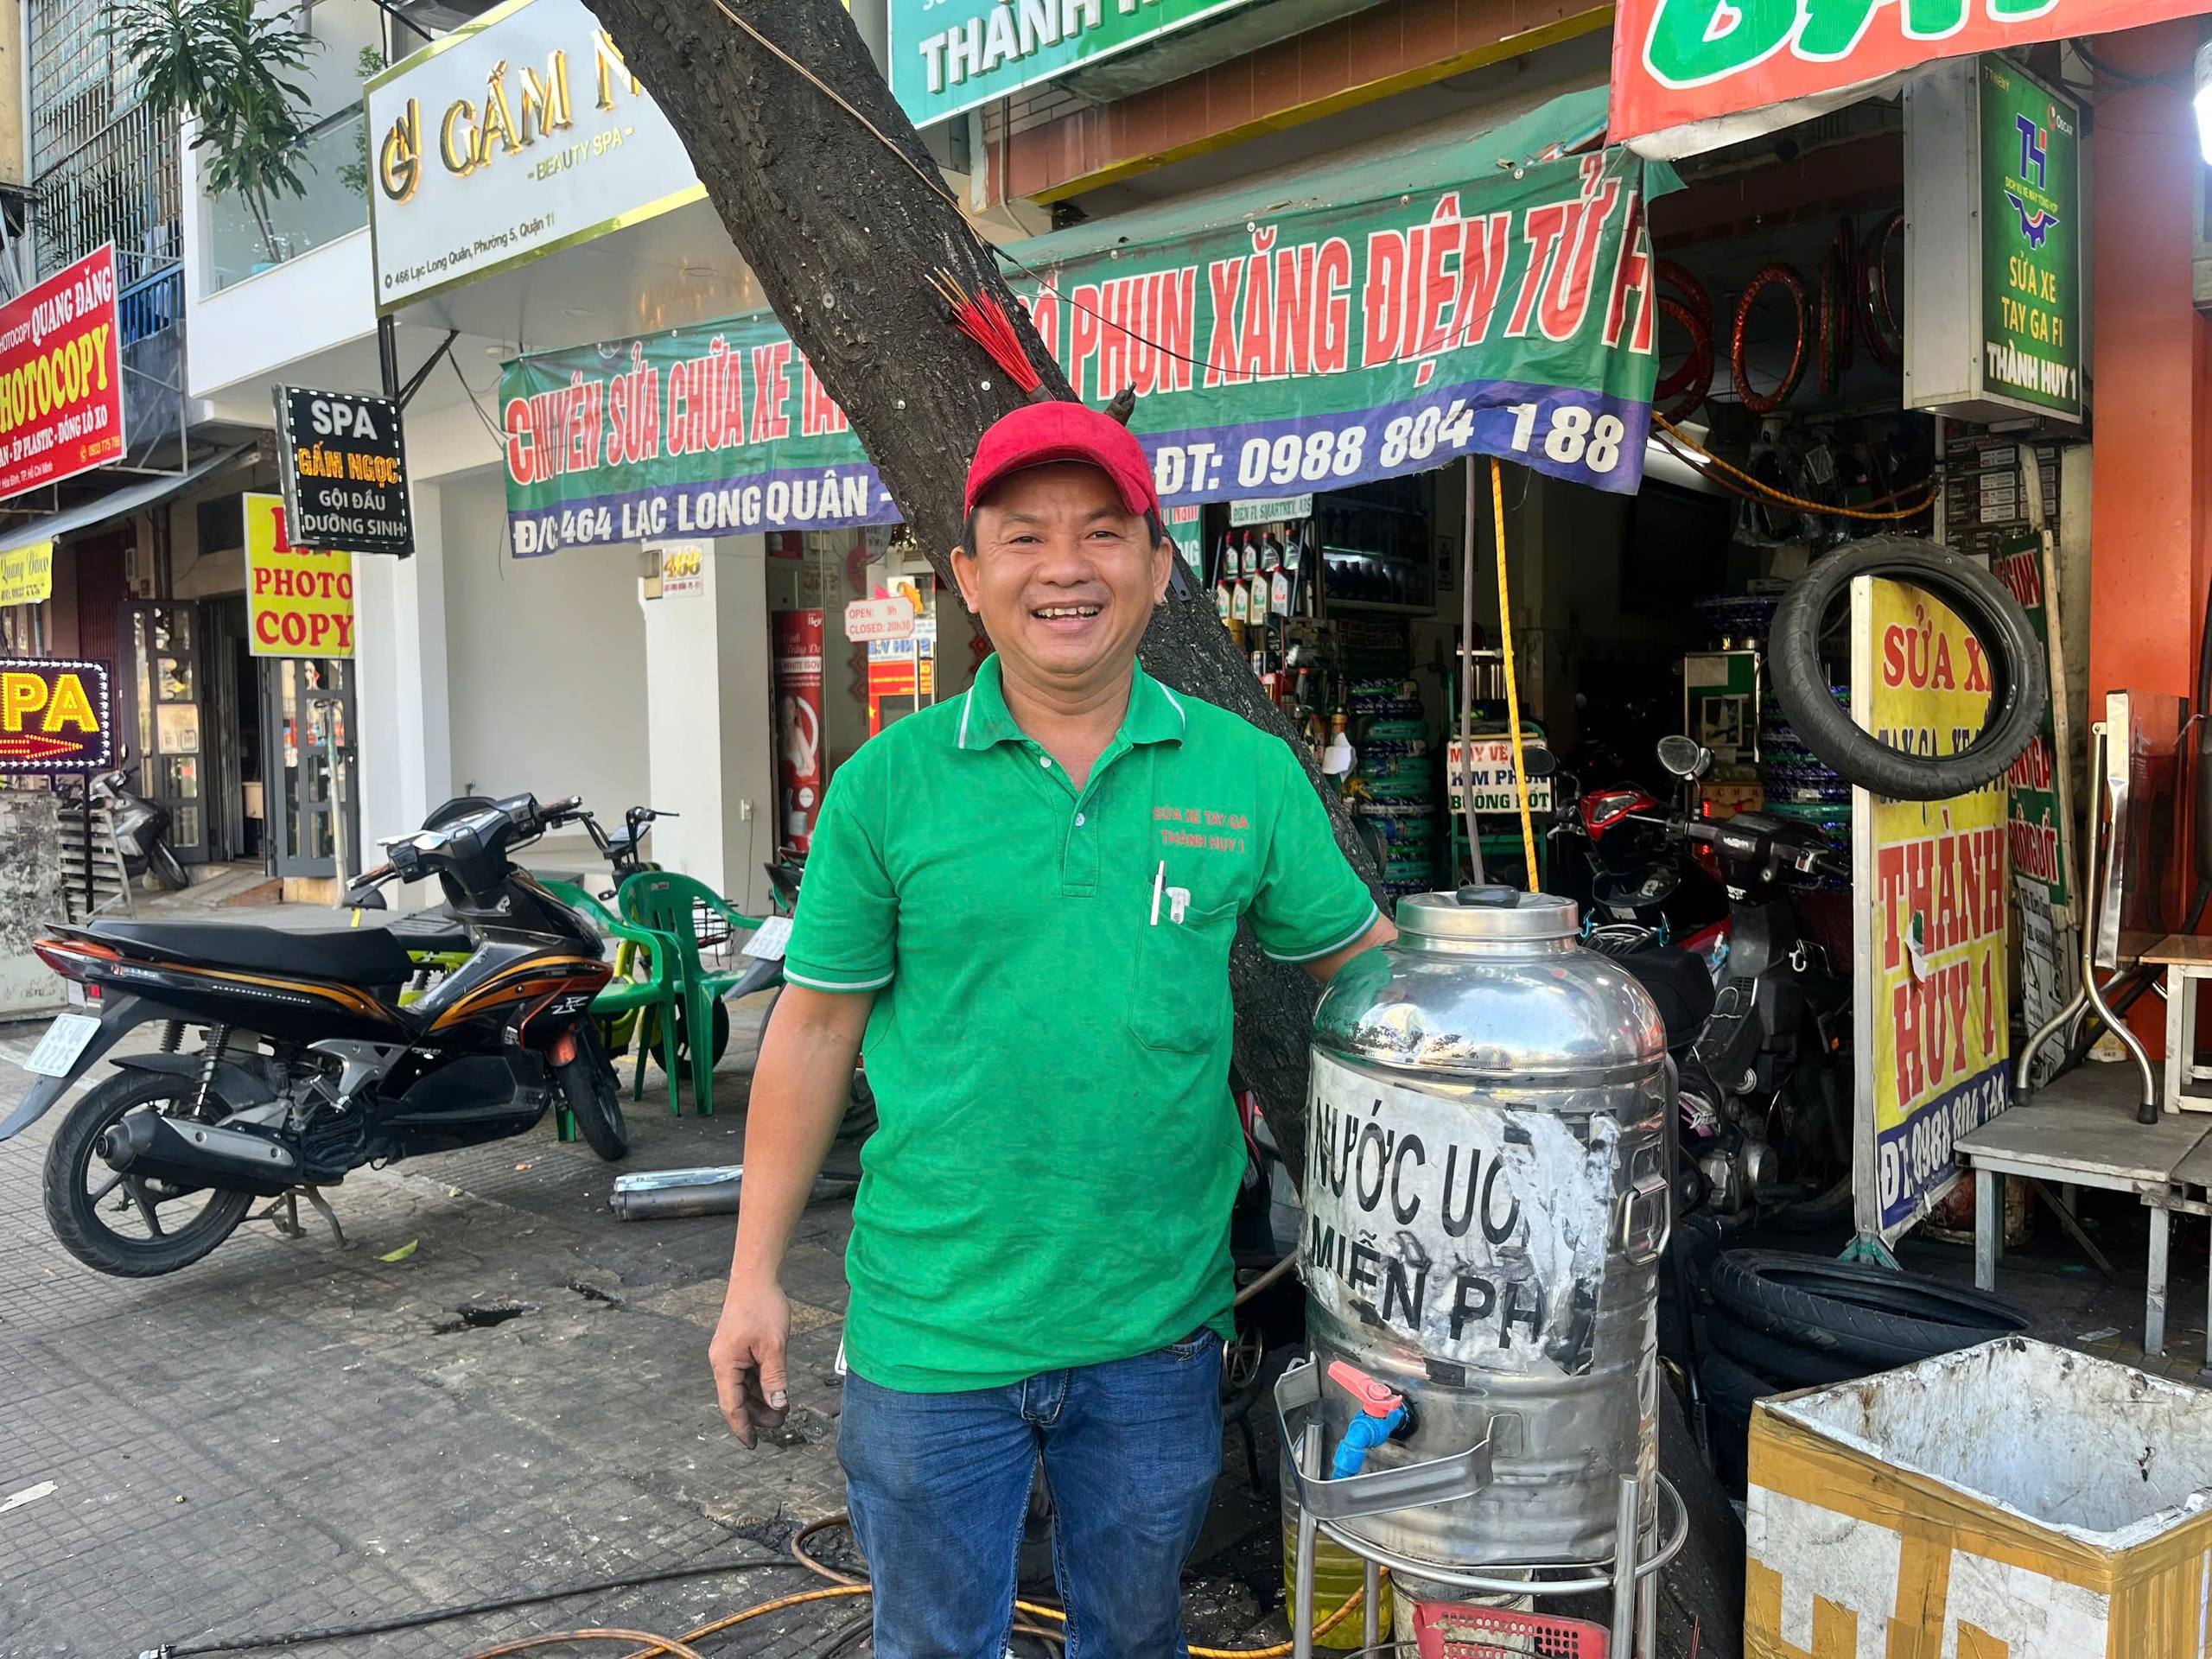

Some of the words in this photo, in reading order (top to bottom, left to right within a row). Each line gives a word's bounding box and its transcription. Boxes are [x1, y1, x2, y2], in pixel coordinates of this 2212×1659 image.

[440, 50, 572, 177] GẤM
[410, 266, 426, 282] Lạc
[427, 257, 448, 273] Long
[520, 217, 544, 237] Quận
[1068, 264, 1198, 403] PHUN
[1202, 226, 1352, 389] XĂNG
[1361, 191, 1513, 389] ĐIỆN
[1503, 154, 1624, 342] TỬ
[2009, 250, 2037, 295] SỬA
[2040, 269, 2057, 304] XE
[32, 289, 73, 347] QUANG
[74, 264, 112, 318] ĐĂNG
[2000, 296, 2026, 333] TAY
[2030, 308, 2049, 343] GA
[2052, 316, 2063, 347] FI
[1986, 340, 2038, 390] THÀNH
[2041, 359, 2069, 399] HUY
[2070, 368, 2077, 401] 1
[311, 399, 378, 442] SPA
[607, 340, 659, 467] SỬA
[666, 334, 745, 457] CHỮA
[749, 340, 791, 445] XE
[22, 427, 54, 458] PLASTIC
[94, 404, 108, 430] XO
[1154, 442, 1224, 495] ĐT:
[1237, 425, 1367, 489] 0988
[1379, 398, 1474, 468] 804
[1506, 402, 1624, 474] 188
[298, 440, 344, 480] GẤM
[347, 454, 400, 489] NGỌC
[304, 512, 364, 536] DƯỠNG
[368, 518, 404, 537] SINH
[319, 487, 349, 512] GỘI
[352, 486, 386, 512] ĐẦU
[561, 506, 613, 544] 464
[622, 496, 668, 545] LẠC
[677, 486, 762, 531] LONG
[766, 470, 869, 526] QUÂN
[254, 567, 353, 600] PHOTO
[664, 550, 702, 578] 466
[256, 610, 354, 648] COPY
[849, 607, 874, 620] OPEN:
[887, 606, 897, 616] 9h
[849, 623, 886, 635] CLOSED:
[887, 620, 911, 632] 20h30
[1883, 603, 1956, 691] SỬA
[1964, 636, 1993, 692] X
[2, 672, 101, 733] PA
[1451, 770, 1490, 787] KM
[1451, 787, 1510, 810] BỒNG
[1153, 804, 1182, 821] SỬA
[1185, 809, 1202, 823] XE
[1205, 811, 1226, 827] TAY
[1228, 816, 1249, 830] GA
[1210, 838, 1236, 852] HUY
[1878, 804, 2005, 971] THÀNH
[1892, 955, 1970, 1112] HUY
[1980, 949, 1996, 1059] 1
[1911, 1103, 1951, 1185] 0988
[1315, 1097, 1427, 1226] NƯỚC
[1441, 1144, 1520, 1246] UO
[1312, 1214, 1425, 1332] MIỄN
